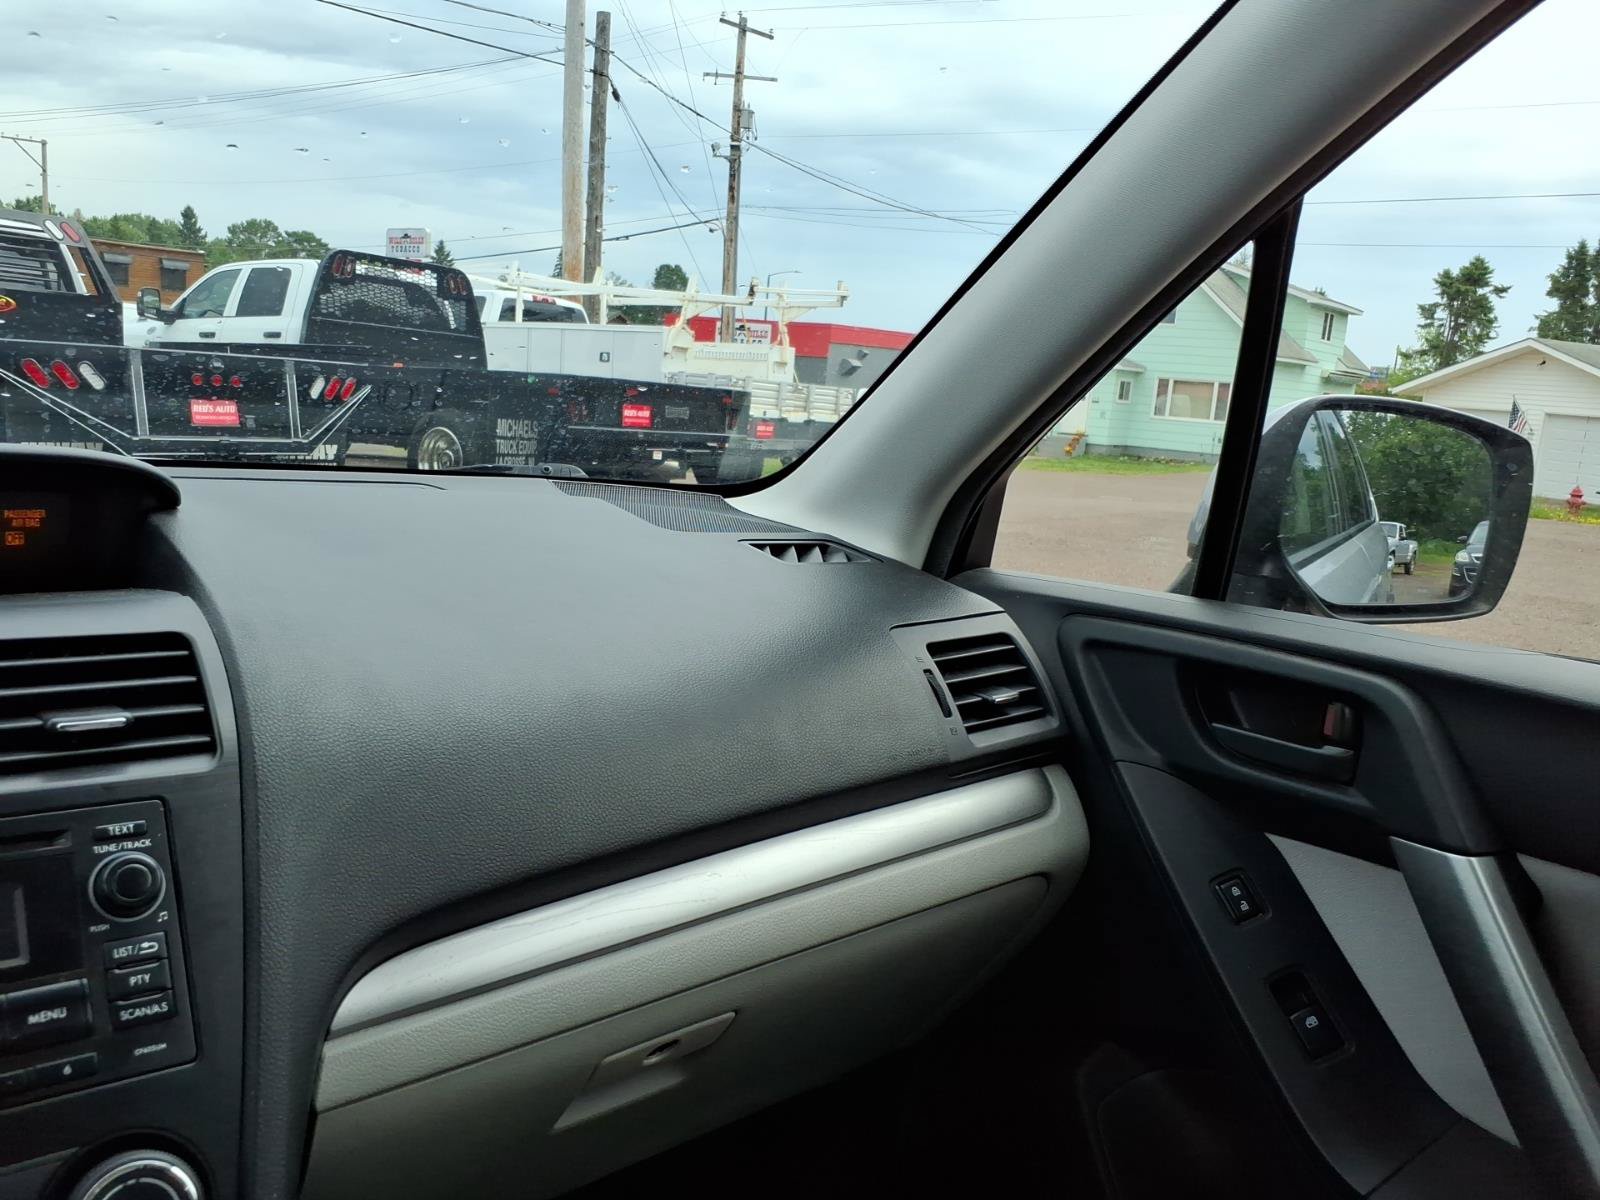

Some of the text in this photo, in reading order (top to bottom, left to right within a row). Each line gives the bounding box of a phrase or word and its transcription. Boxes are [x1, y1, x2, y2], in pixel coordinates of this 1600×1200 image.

[390, 245, 421, 253] TOBACCO
[215, 405, 236, 413] AUTO
[496, 439, 517, 455] TRUCK
[107, 824, 135, 836] TEXT
[91, 839, 152, 854] TUNE/TRACK
[129, 973, 151, 987] PTY
[27, 1006, 68, 1025] MENU
